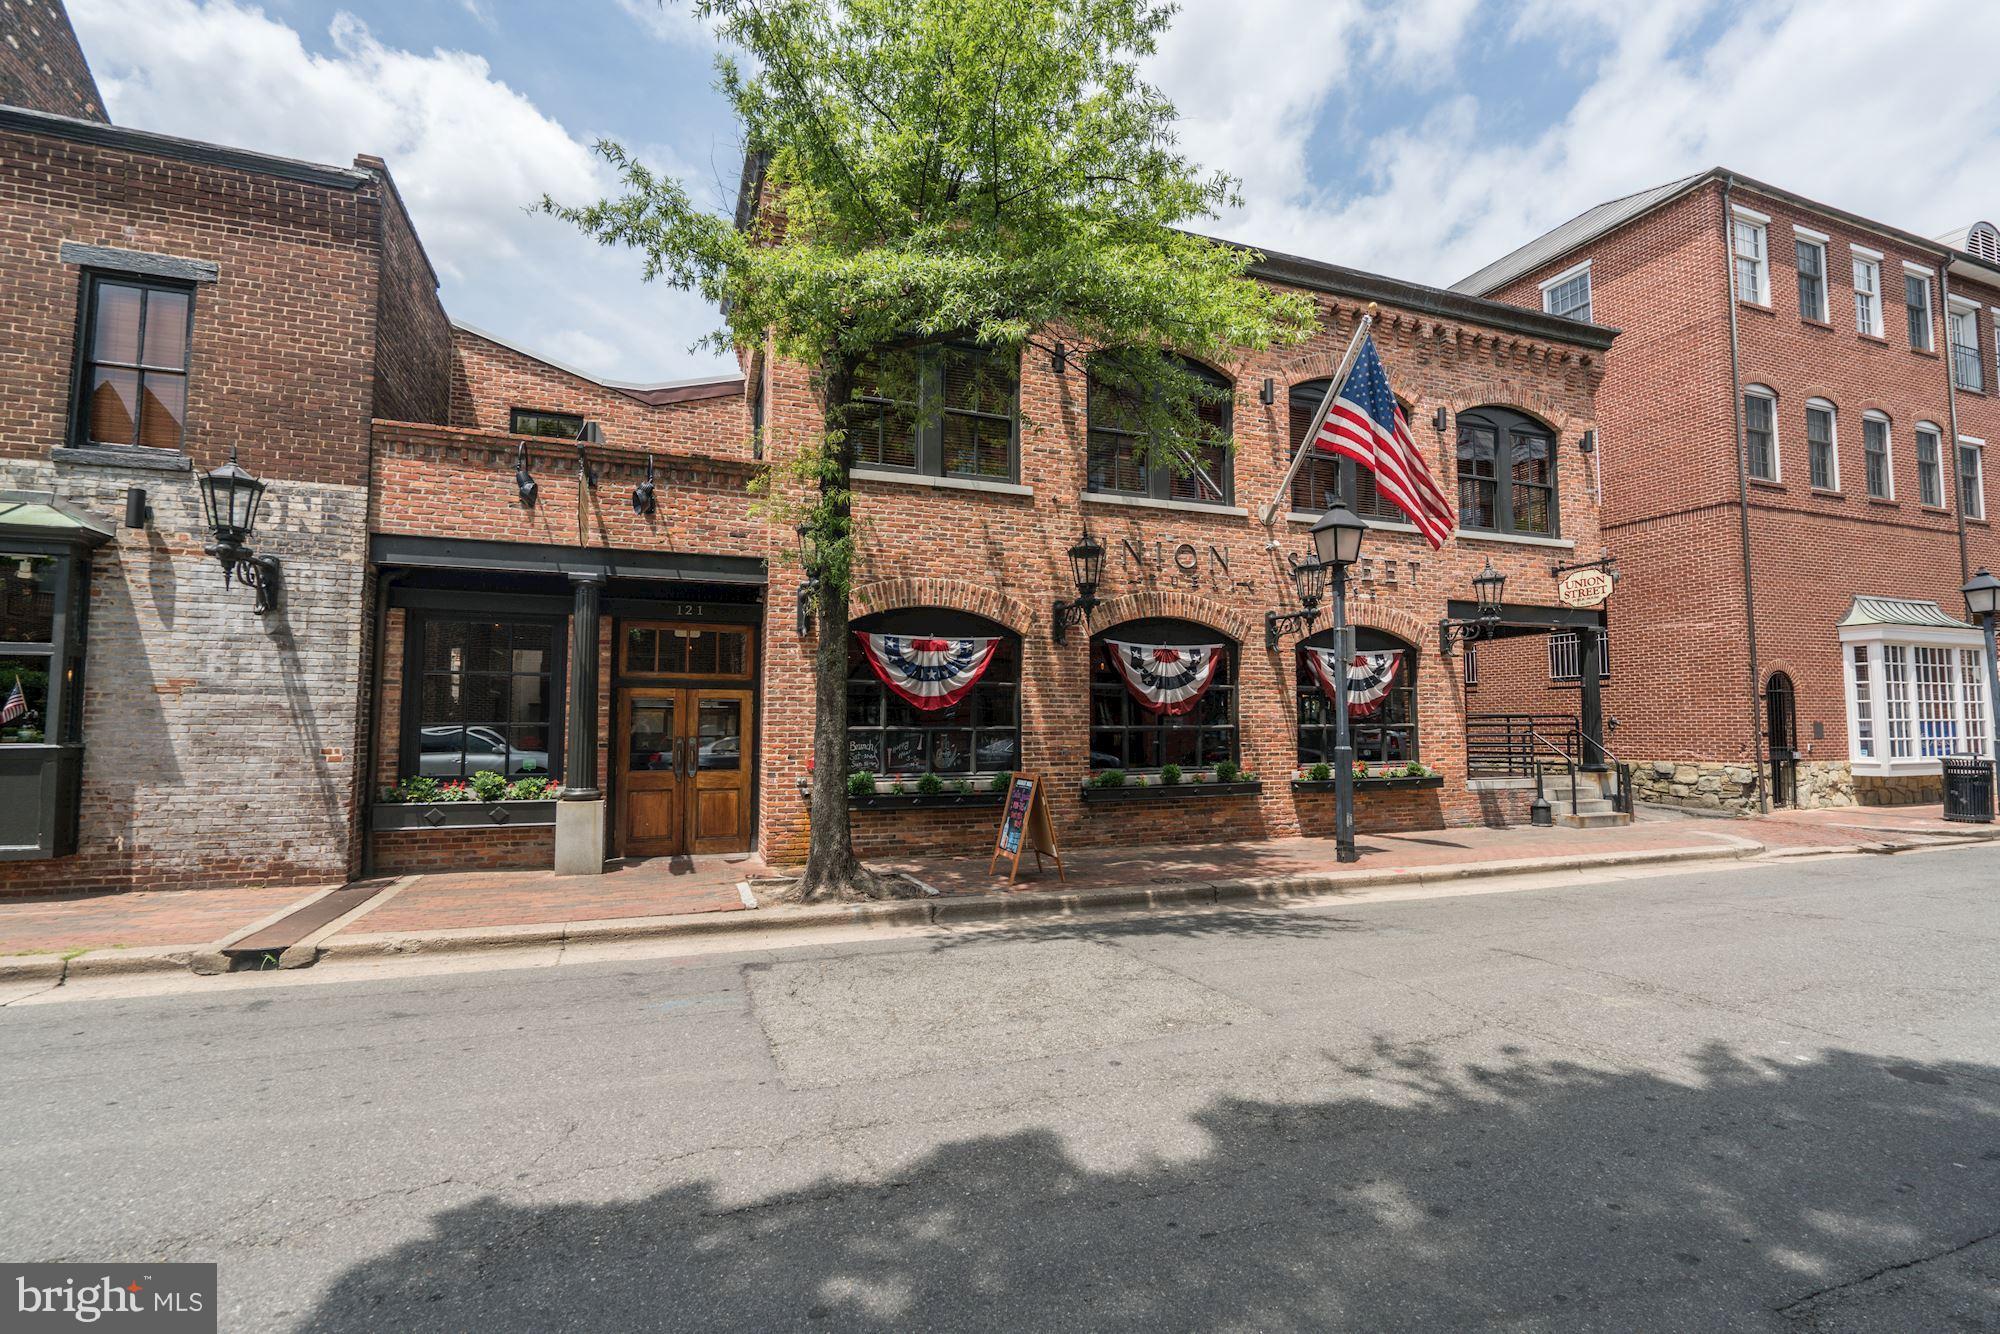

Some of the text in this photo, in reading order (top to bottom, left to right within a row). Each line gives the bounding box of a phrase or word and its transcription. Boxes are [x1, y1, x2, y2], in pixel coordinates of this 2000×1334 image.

[1102, 537, 1230, 577] NION
[1288, 552, 1421, 586] SEET
[1565, 576, 1605, 590] UNION
[1564, 585, 1607, 600] STREET
[677, 605, 704, 616] 121
[849, 739, 874, 751] Brunch
